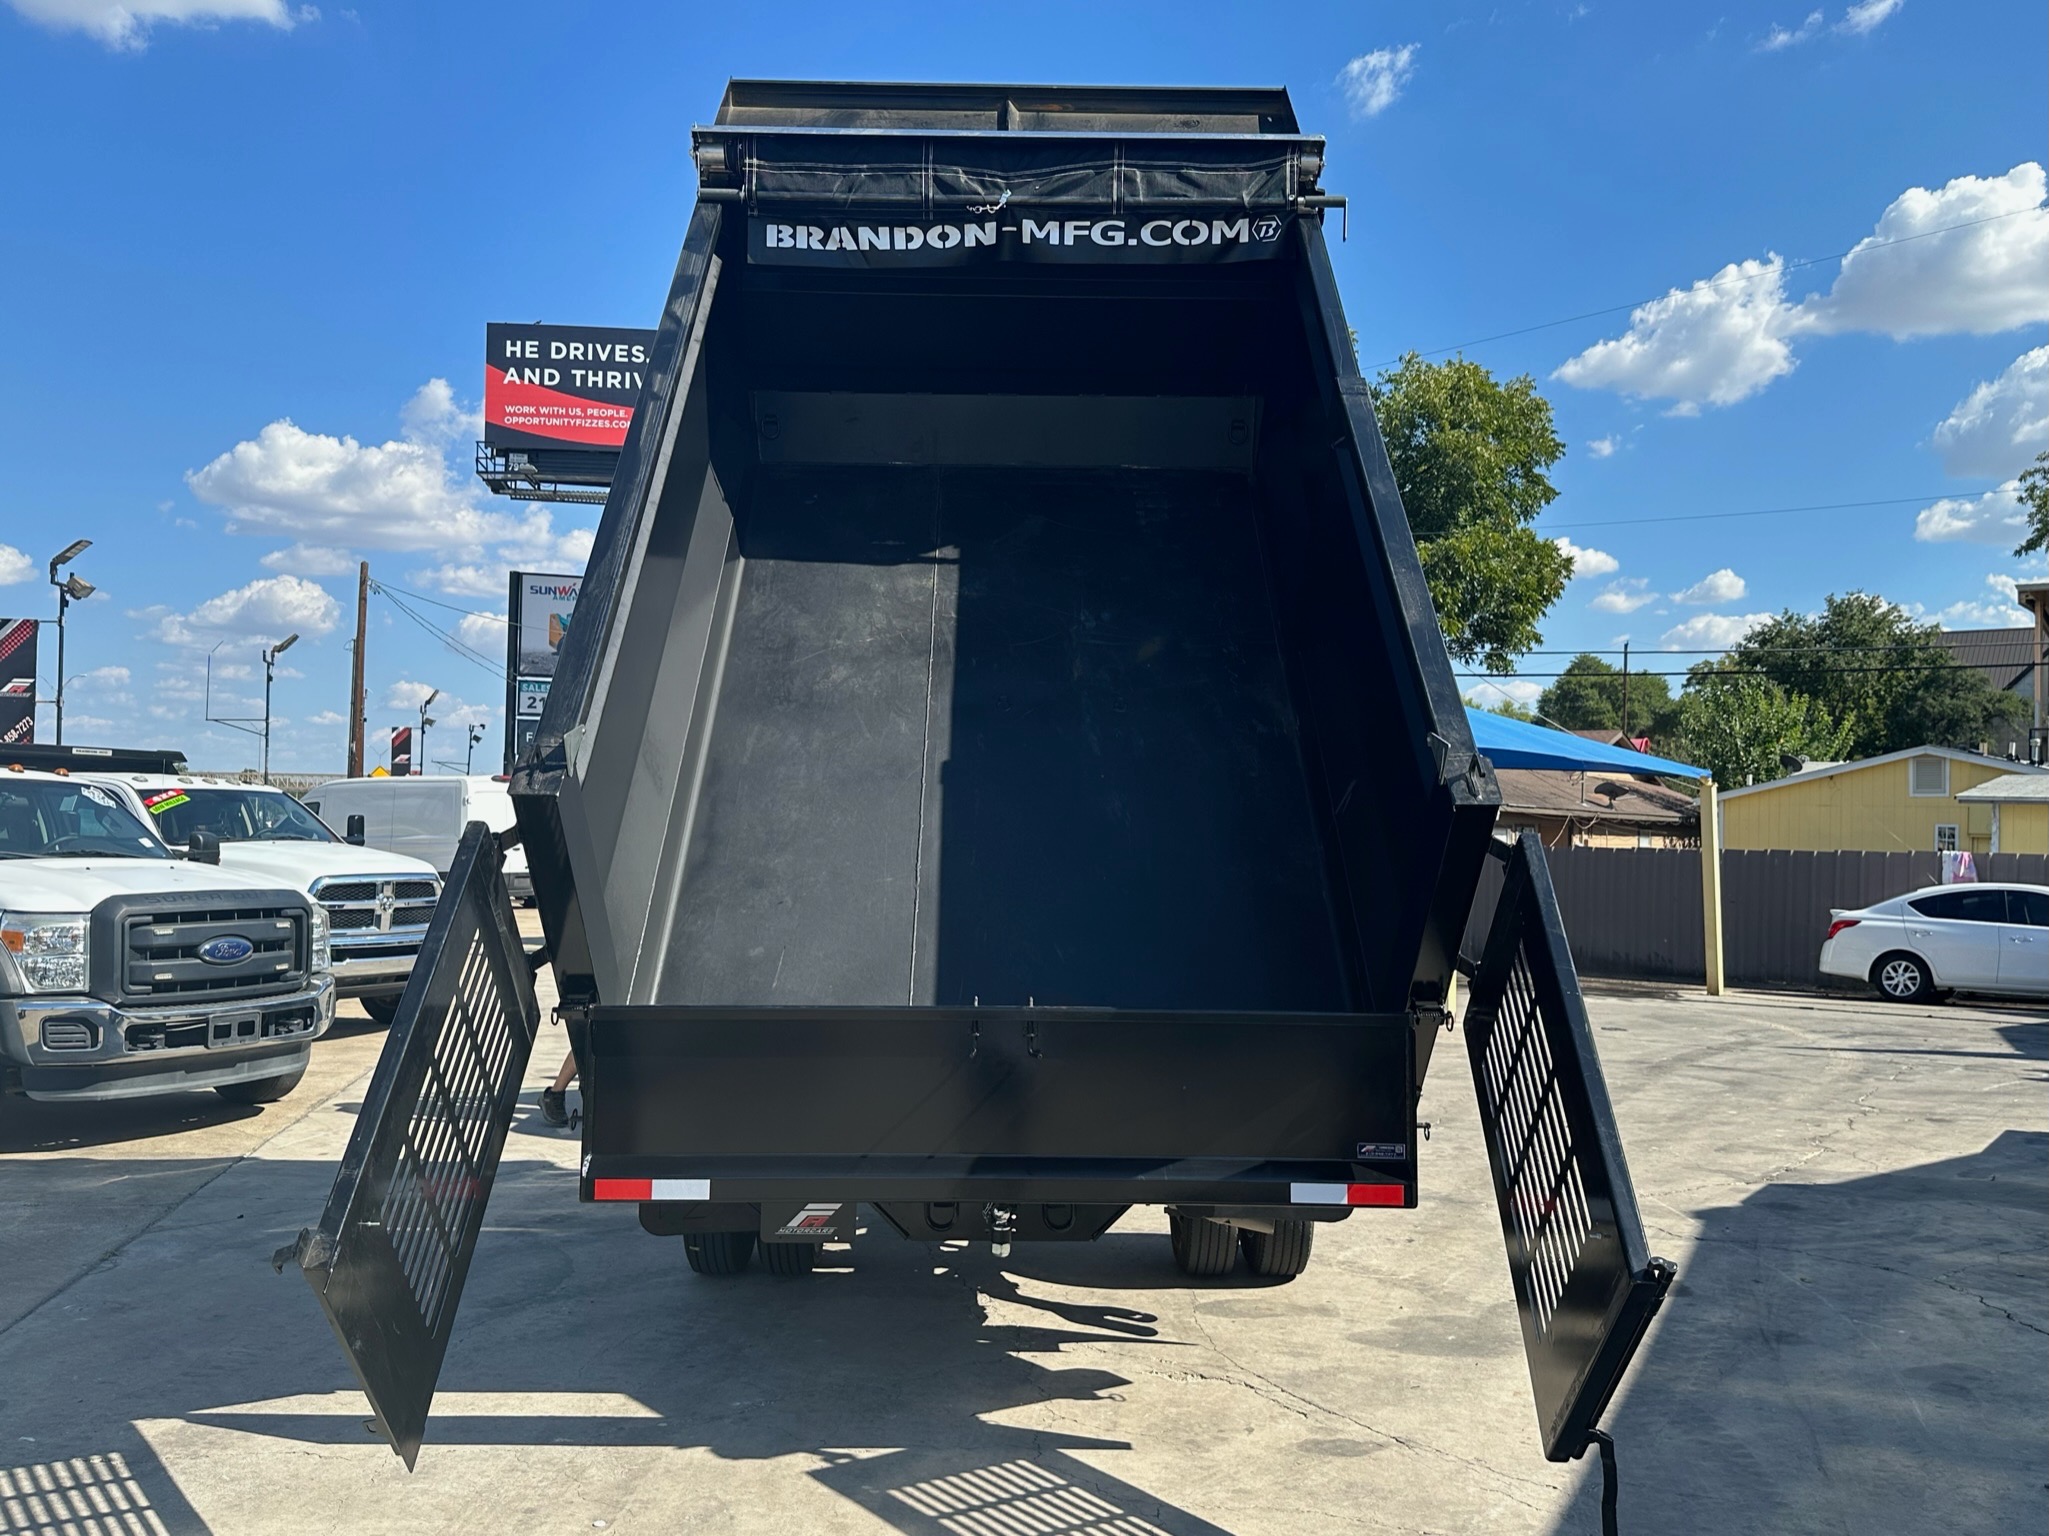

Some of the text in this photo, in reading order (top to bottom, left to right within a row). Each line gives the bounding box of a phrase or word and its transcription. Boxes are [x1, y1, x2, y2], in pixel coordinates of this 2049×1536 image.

[766, 218, 1250, 251] BRANDON-MFG.COM
[505, 340, 539, 358] HE
[503, 367, 561, 386] AND
[504, 405, 628, 418] WORK WITH US, PEOPLE.
[530, 582, 580, 597] SUNWA
[144, 892, 223, 904] SUPER
[215, 942, 243, 957] Ford
